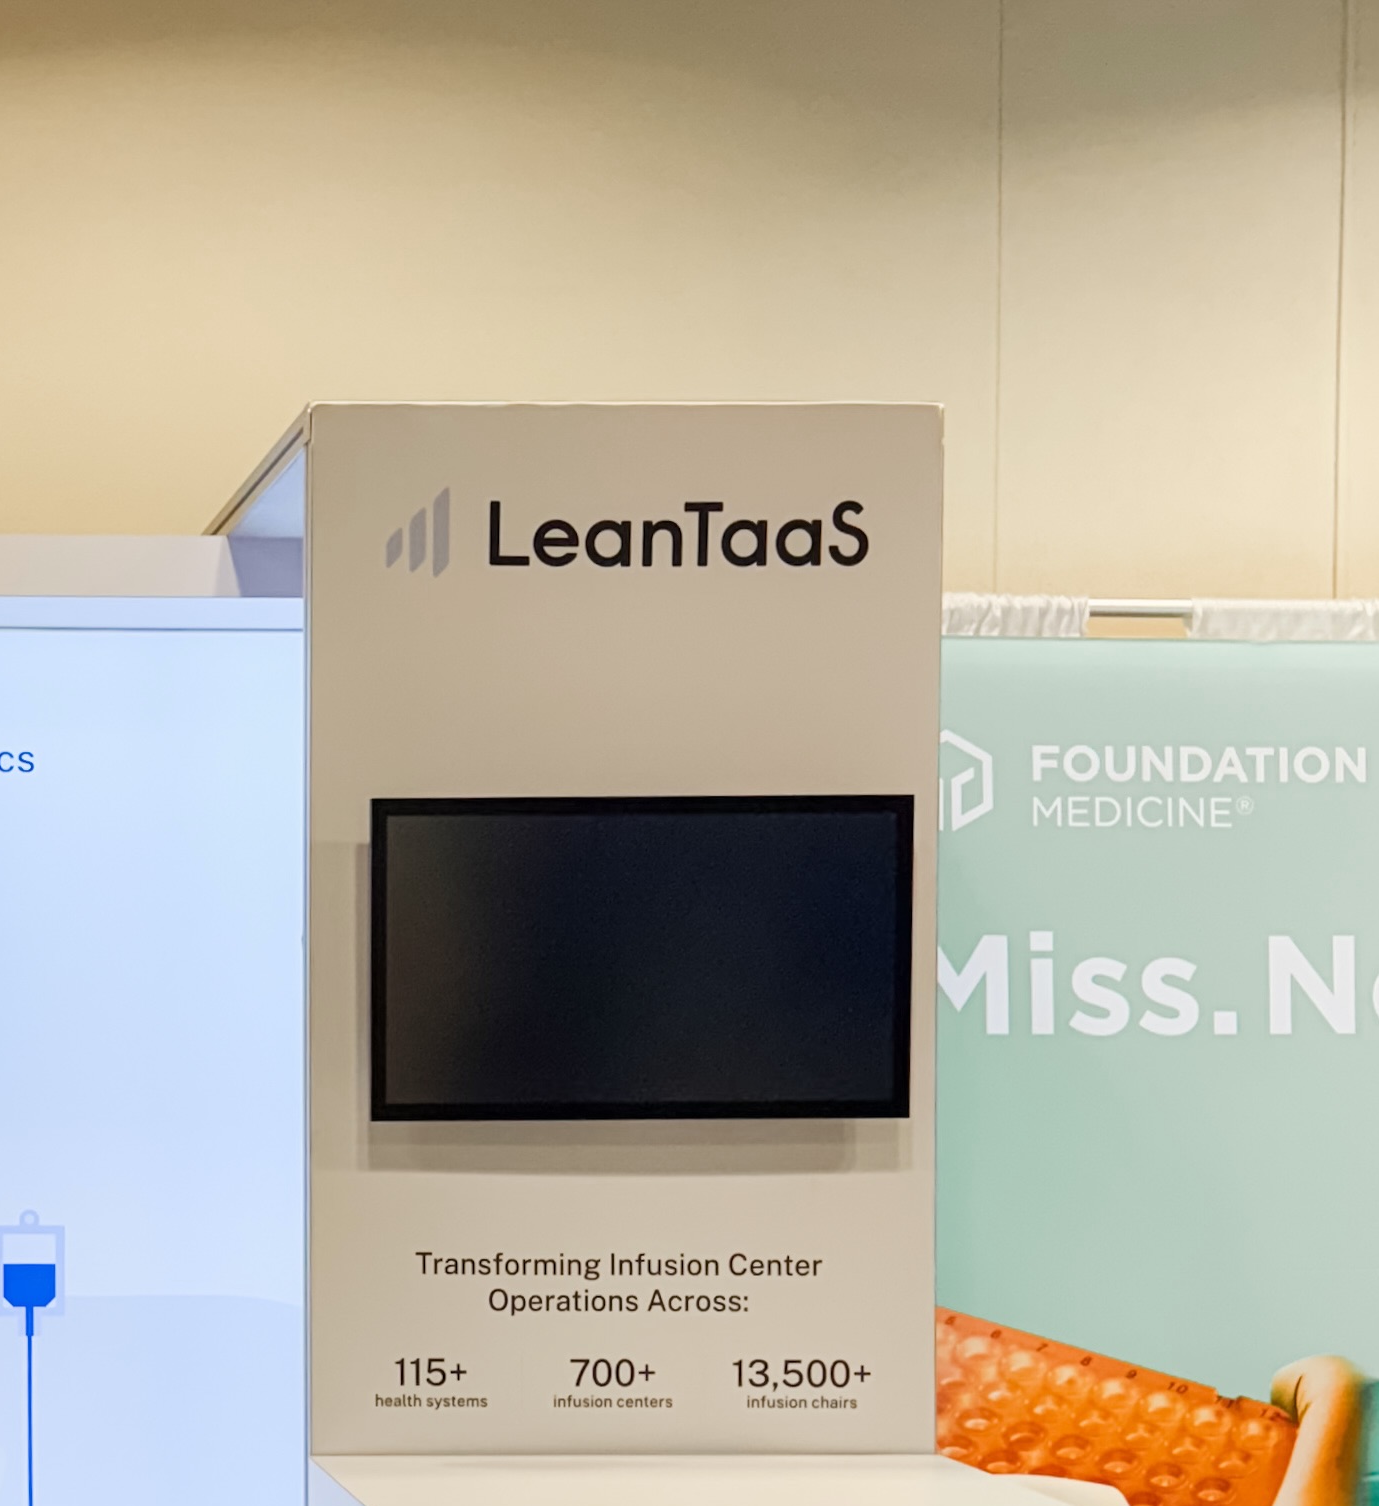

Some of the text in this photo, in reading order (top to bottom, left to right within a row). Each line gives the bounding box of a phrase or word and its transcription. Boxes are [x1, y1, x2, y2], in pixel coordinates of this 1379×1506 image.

[488, 500, 869, 568] LeanTaaS
[1031, 744, 1368, 784] FOUNDATION
[937, 930, 1379, 1037] Miss. N
[415, 1251, 823, 1281] Transforming Infusion Center
[488, 1288, 749, 1317] Operations Across:
[394, 1357, 468, 1388] 115+
[569, 1358, 656, 1389] 700+
[732, 1358, 872, 1393] 13,500+
[375, 1393, 488, 1411] health systems
[553, 1394, 673, 1409] infusion centers
[746, 1395, 858, 1409] infusion chairs
